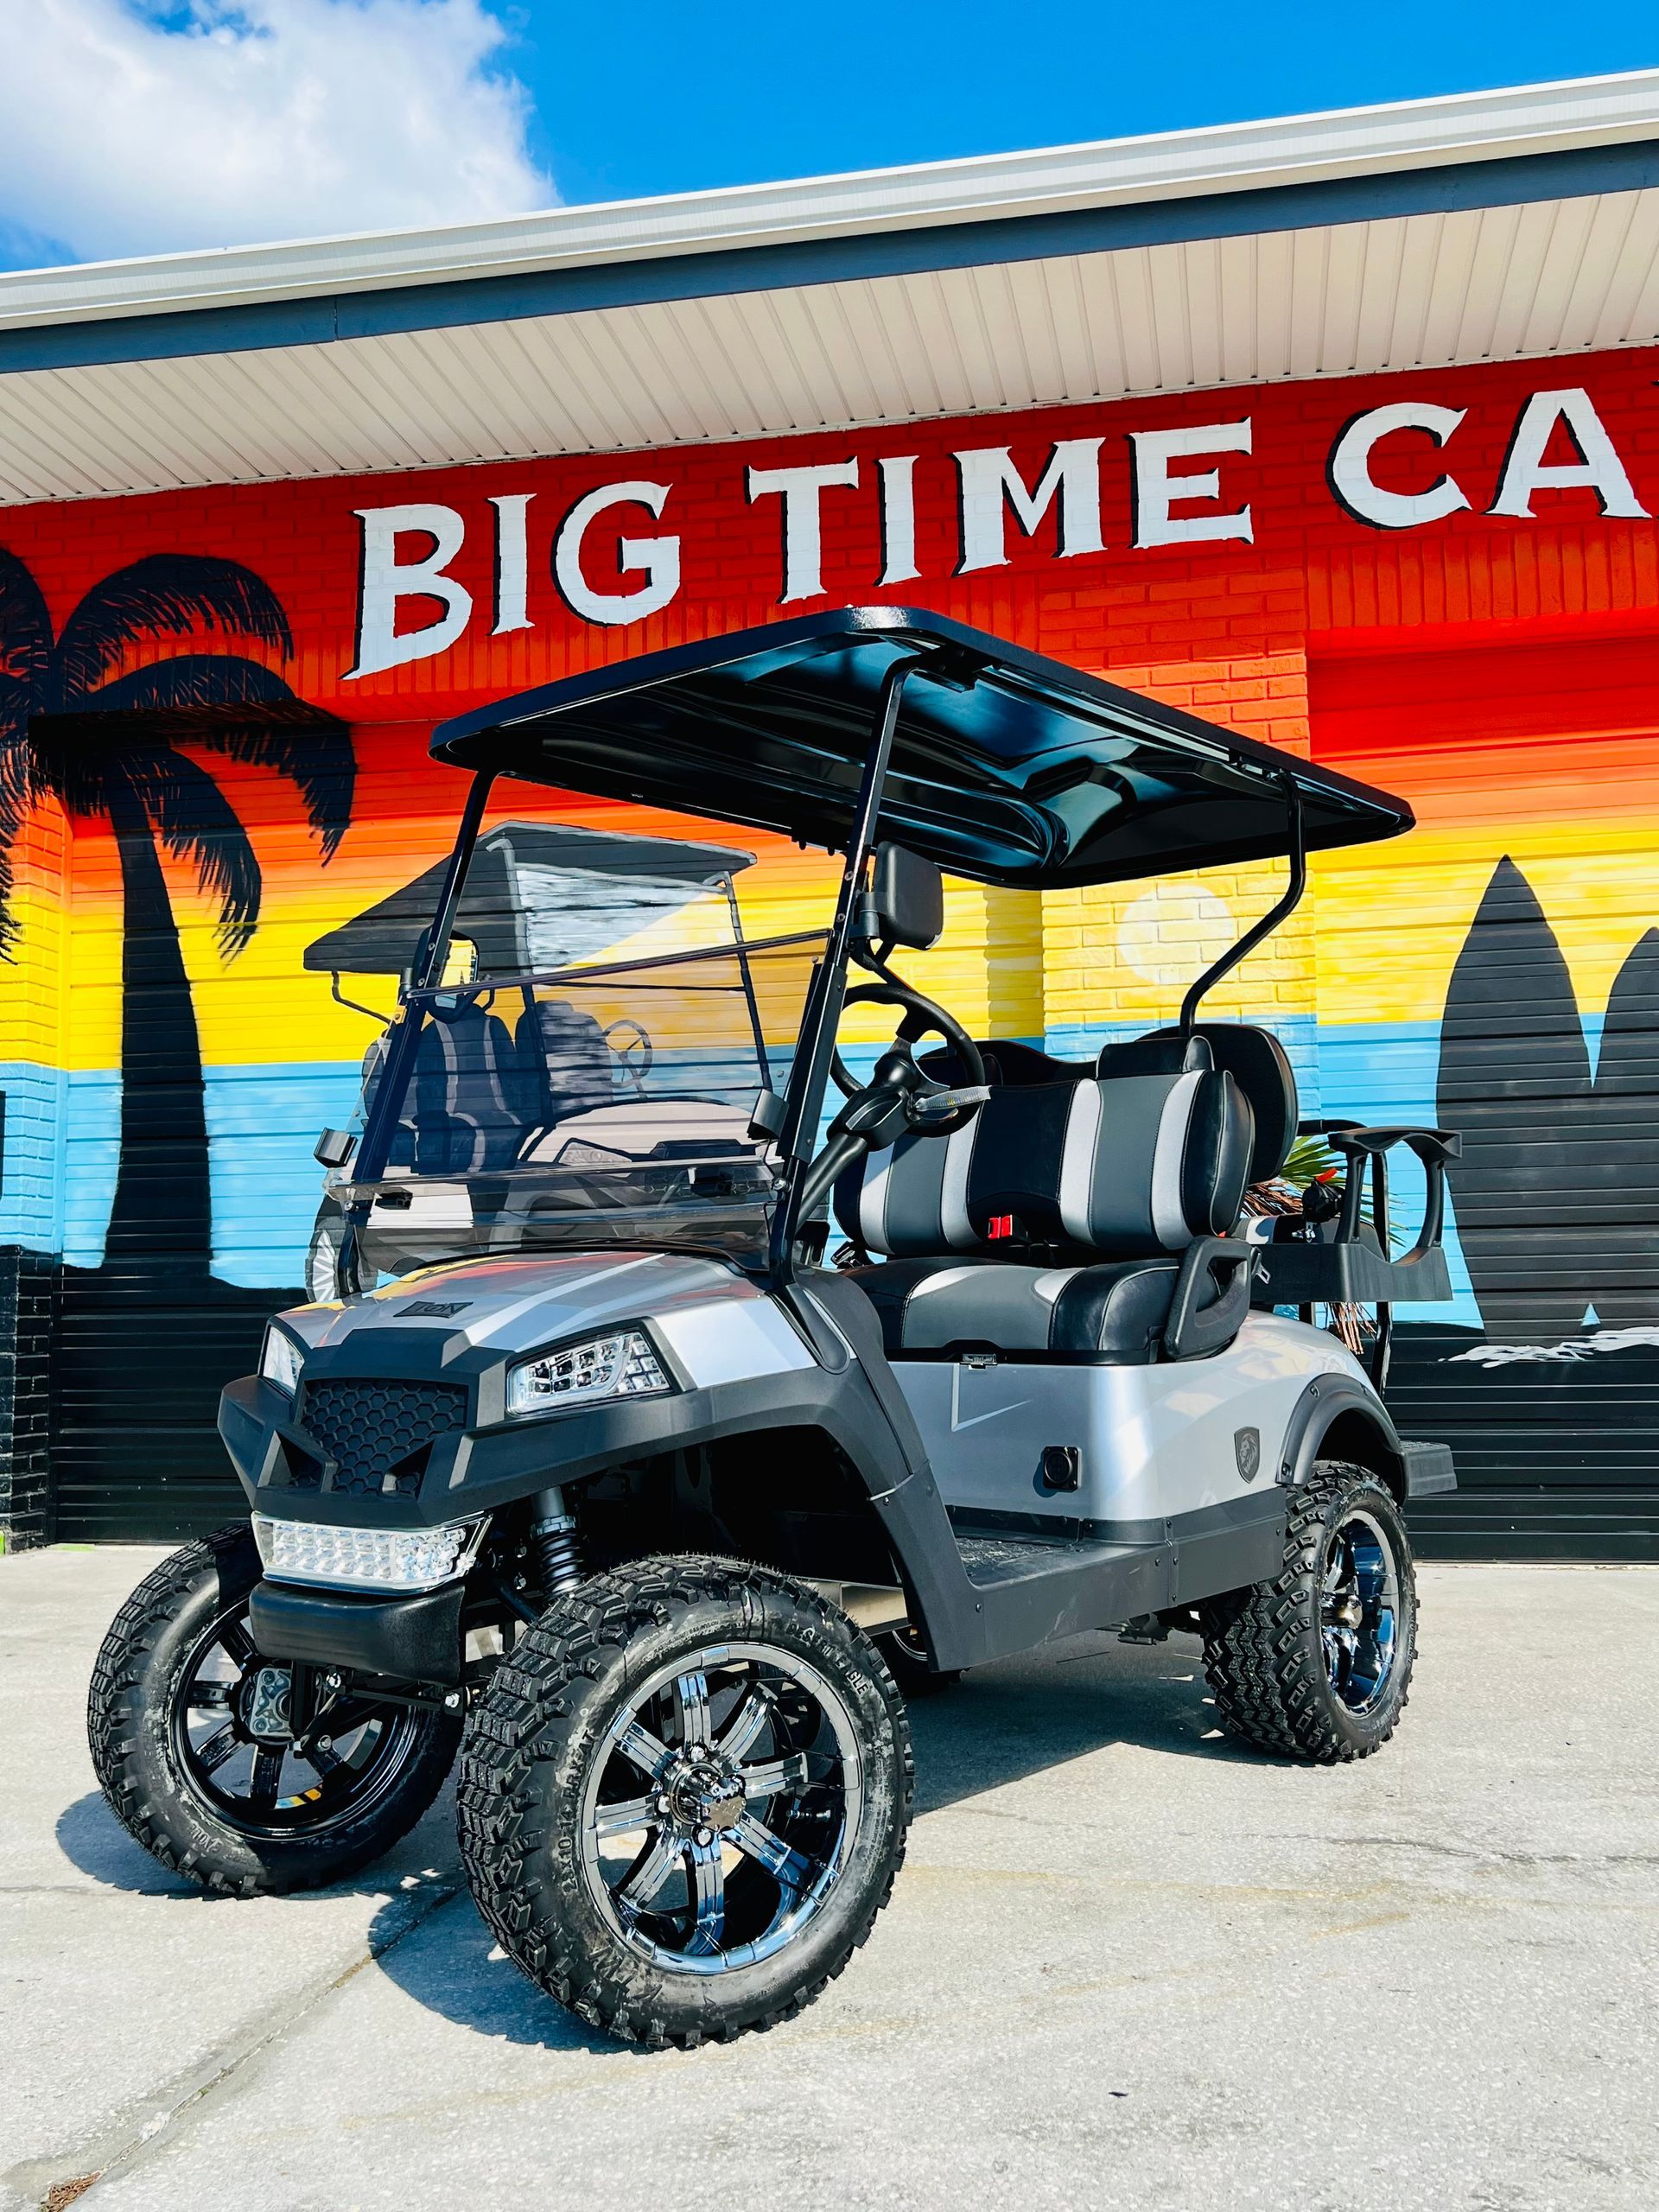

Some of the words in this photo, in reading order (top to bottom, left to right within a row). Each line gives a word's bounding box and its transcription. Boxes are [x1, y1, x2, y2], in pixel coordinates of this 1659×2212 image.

[340, 480, 681, 680] BIG
[745, 416, 1254, 604] TIME
[1325, 378, 1659, 531] CA
[834, 1654, 869, 1695] EAGLE
